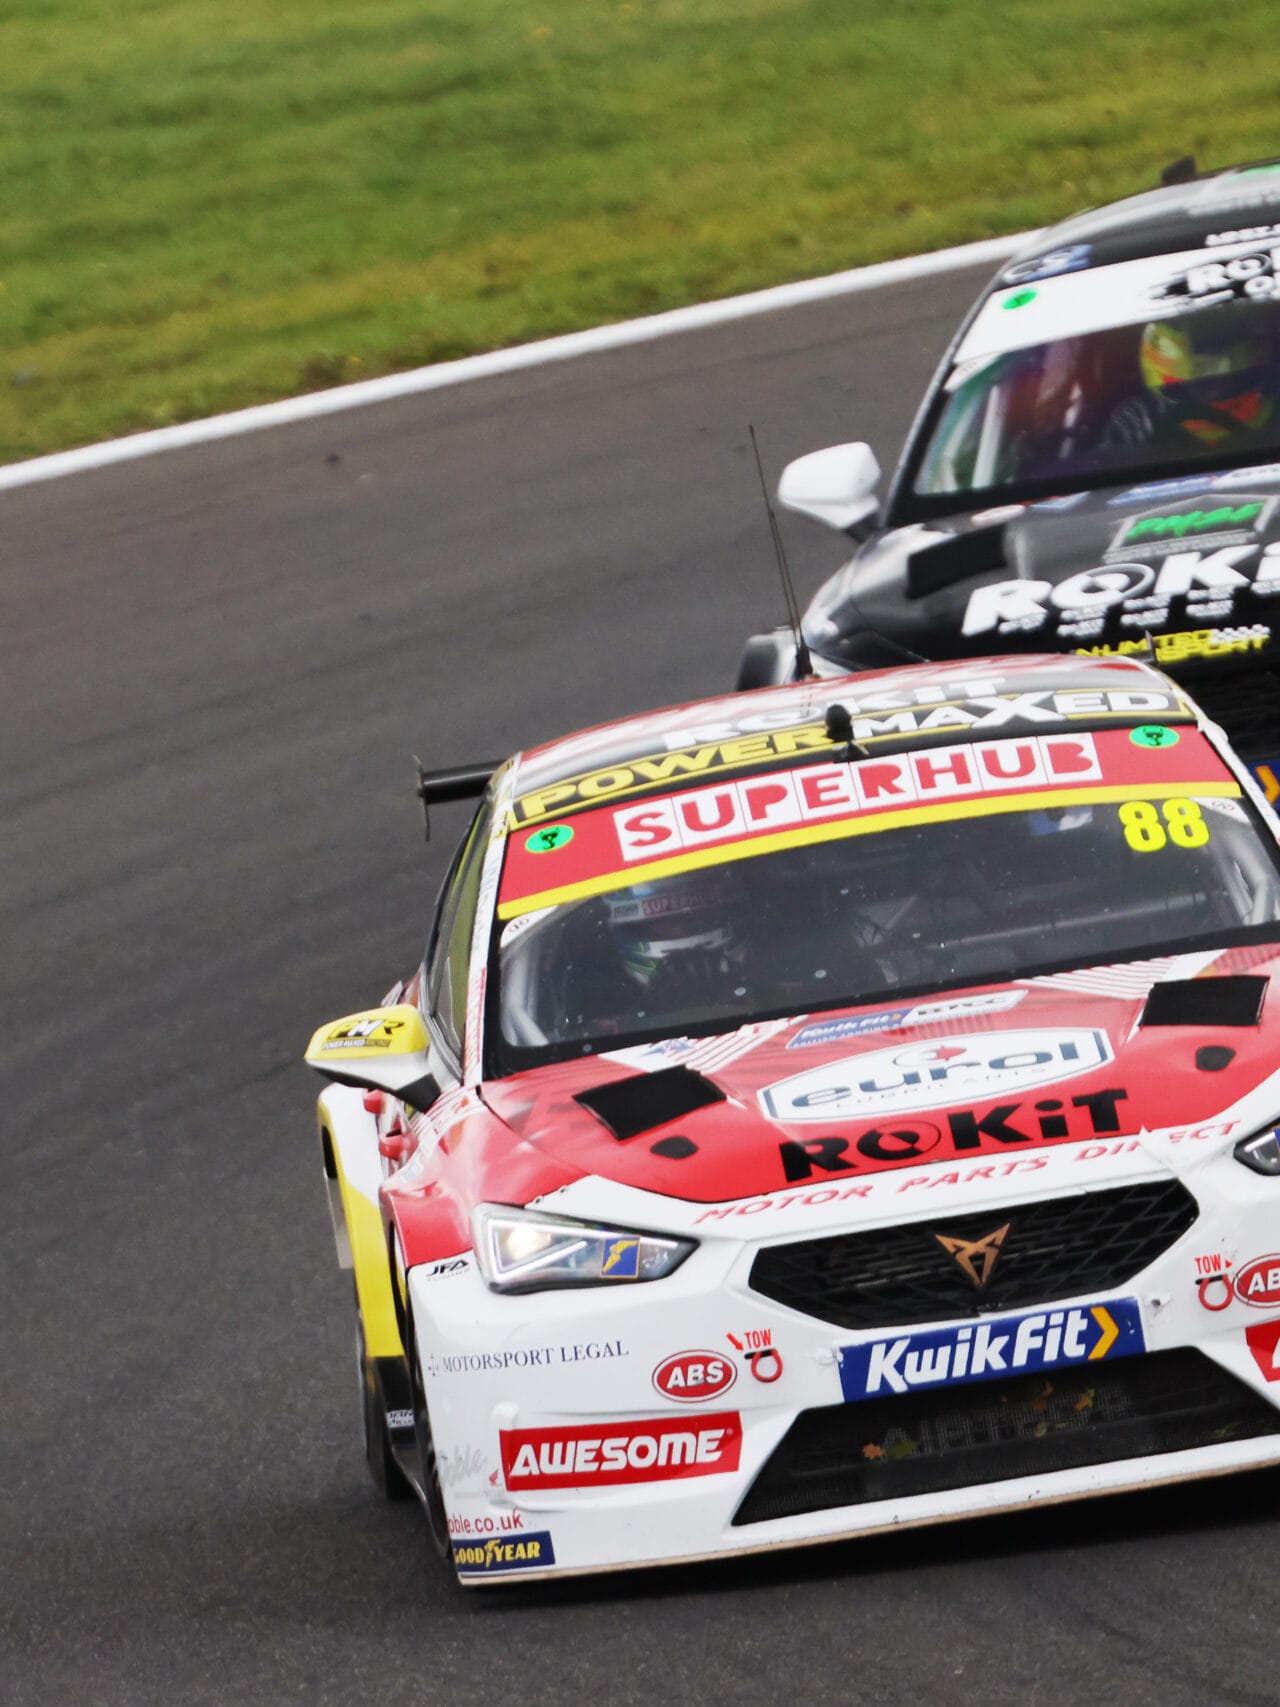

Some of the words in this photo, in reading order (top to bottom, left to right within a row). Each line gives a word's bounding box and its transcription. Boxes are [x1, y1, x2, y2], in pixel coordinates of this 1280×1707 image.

[521, 726, 832, 820] POWER
[850, 689, 1170, 740] MAXED
[623, 742, 1095, 848] SUPERHUB
[1118, 797, 1210, 853] 88
[791, 1042, 1079, 1108] eurol
[693, 1185, 874, 1225] MOTOR
[897, 1155, 1050, 1193] PARTS
[426, 1258, 470, 1277] JFA
[1194, 1253, 1222, 1275] TOW
[442, 1348, 555, 1373] MOTORSPORT
[560, 1339, 630, 1363] LEGAL
[744, 1328, 772, 1349] TOW
[666, 1360, 724, 1389] ABS
[509, 1429, 726, 1477] AWESOME
[448, 1506, 524, 1535] oble.co.uk
